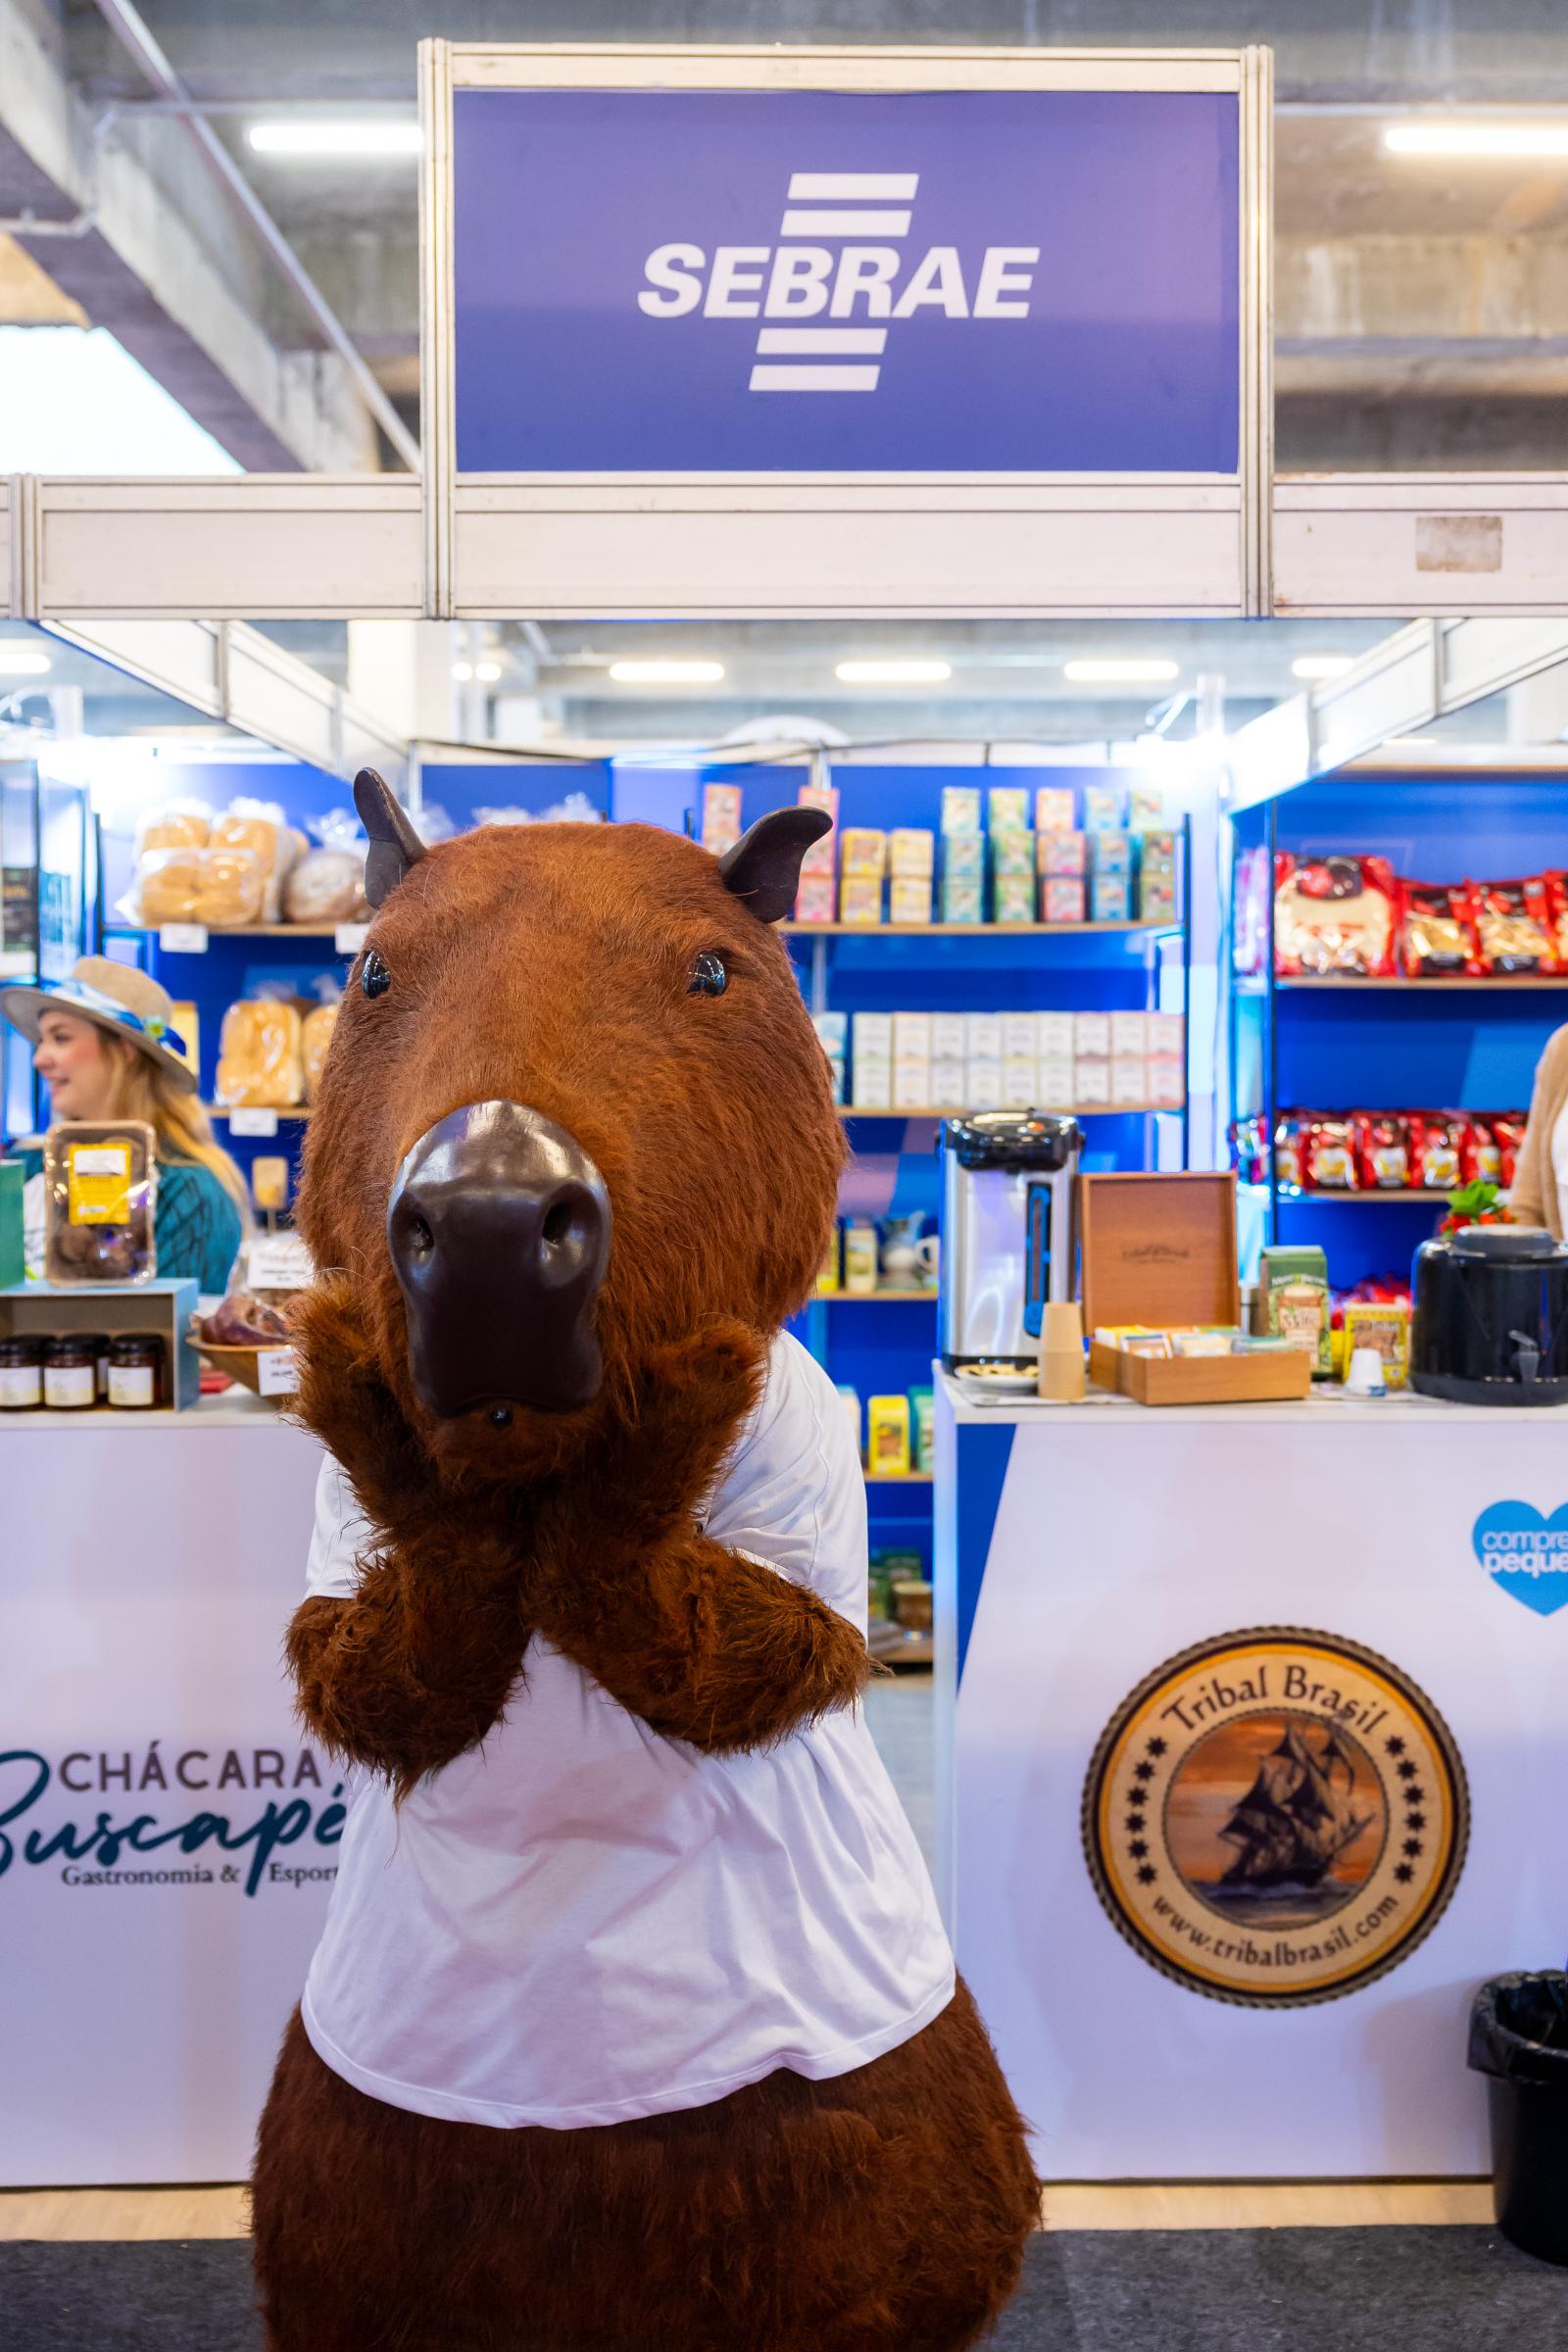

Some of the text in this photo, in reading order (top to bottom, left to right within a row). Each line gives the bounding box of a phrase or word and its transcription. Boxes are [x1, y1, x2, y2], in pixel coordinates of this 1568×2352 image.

[638, 243, 1040, 318] SEBRAE
[1160, 1665, 1389, 1737] Tribal Brasil
[59, 1740, 322, 1792] CHÁCARA
[61, 1865, 215, 1886] Gastronomia
[220, 1865, 240, 1884] &
[1152, 1894, 1399, 1967] www.tribalbrasil.com
